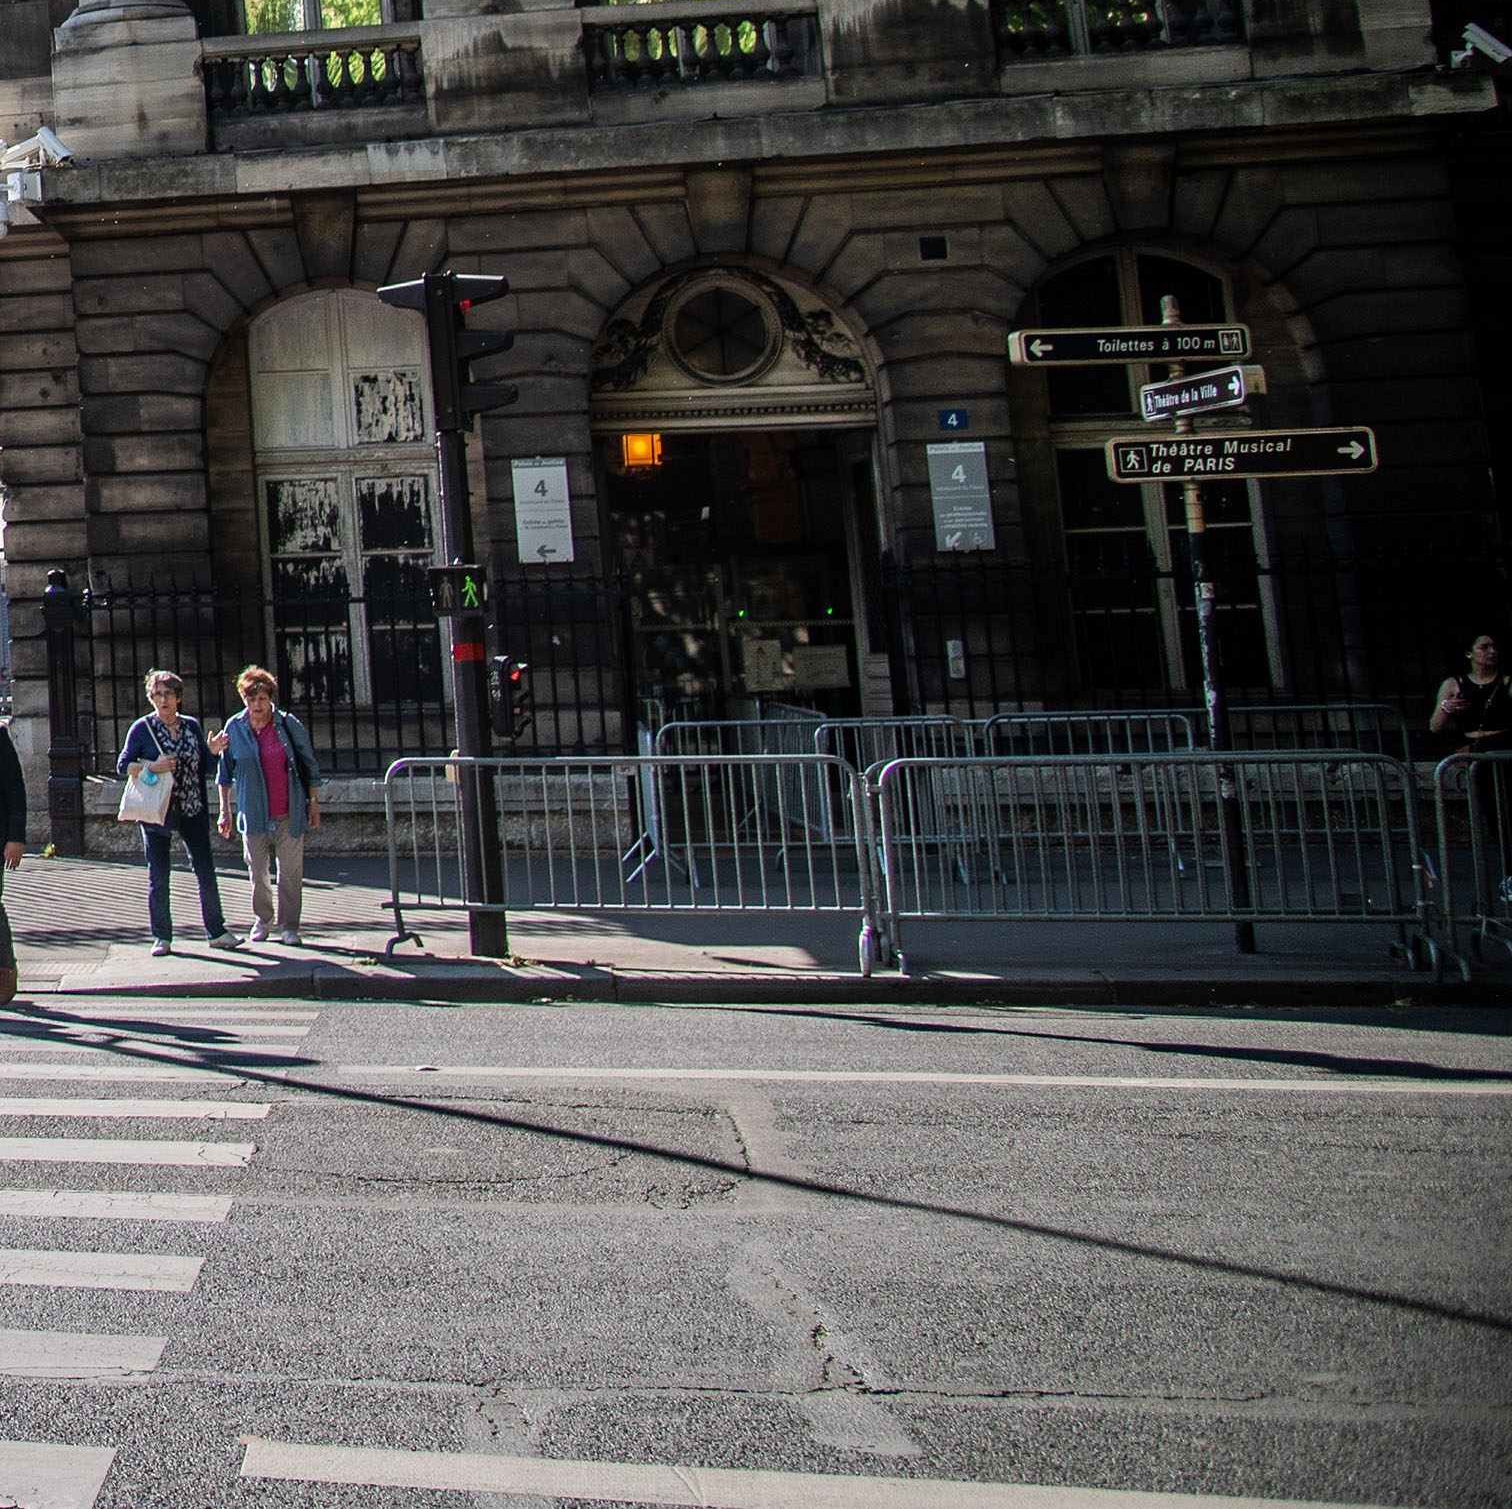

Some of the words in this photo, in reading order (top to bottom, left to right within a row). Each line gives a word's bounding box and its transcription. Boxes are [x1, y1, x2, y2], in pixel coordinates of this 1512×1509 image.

[1097, 339, 1154, 352] Toilettes
[1162, 338, 1170, 351] à
[1177, 337, 1200, 350] 100
[1204, 339, 1215, 349] m
[1154, 393, 1179, 408] Théâtre
[1181, 389, 1190, 403] de
[1191, 388, 1199, 401] la
[1199, 384, 1218, 399] Ville
[947, 413, 959, 427] 4
[1150, 443, 1213, 457] Théâtre
[1224, 438, 1292, 454] Musical
[951, 464, 967, 483] 4
[1152, 460, 1172, 473] de
[1184, 457, 1236, 472] PARIS
[534, 479, 548, 497] 4
